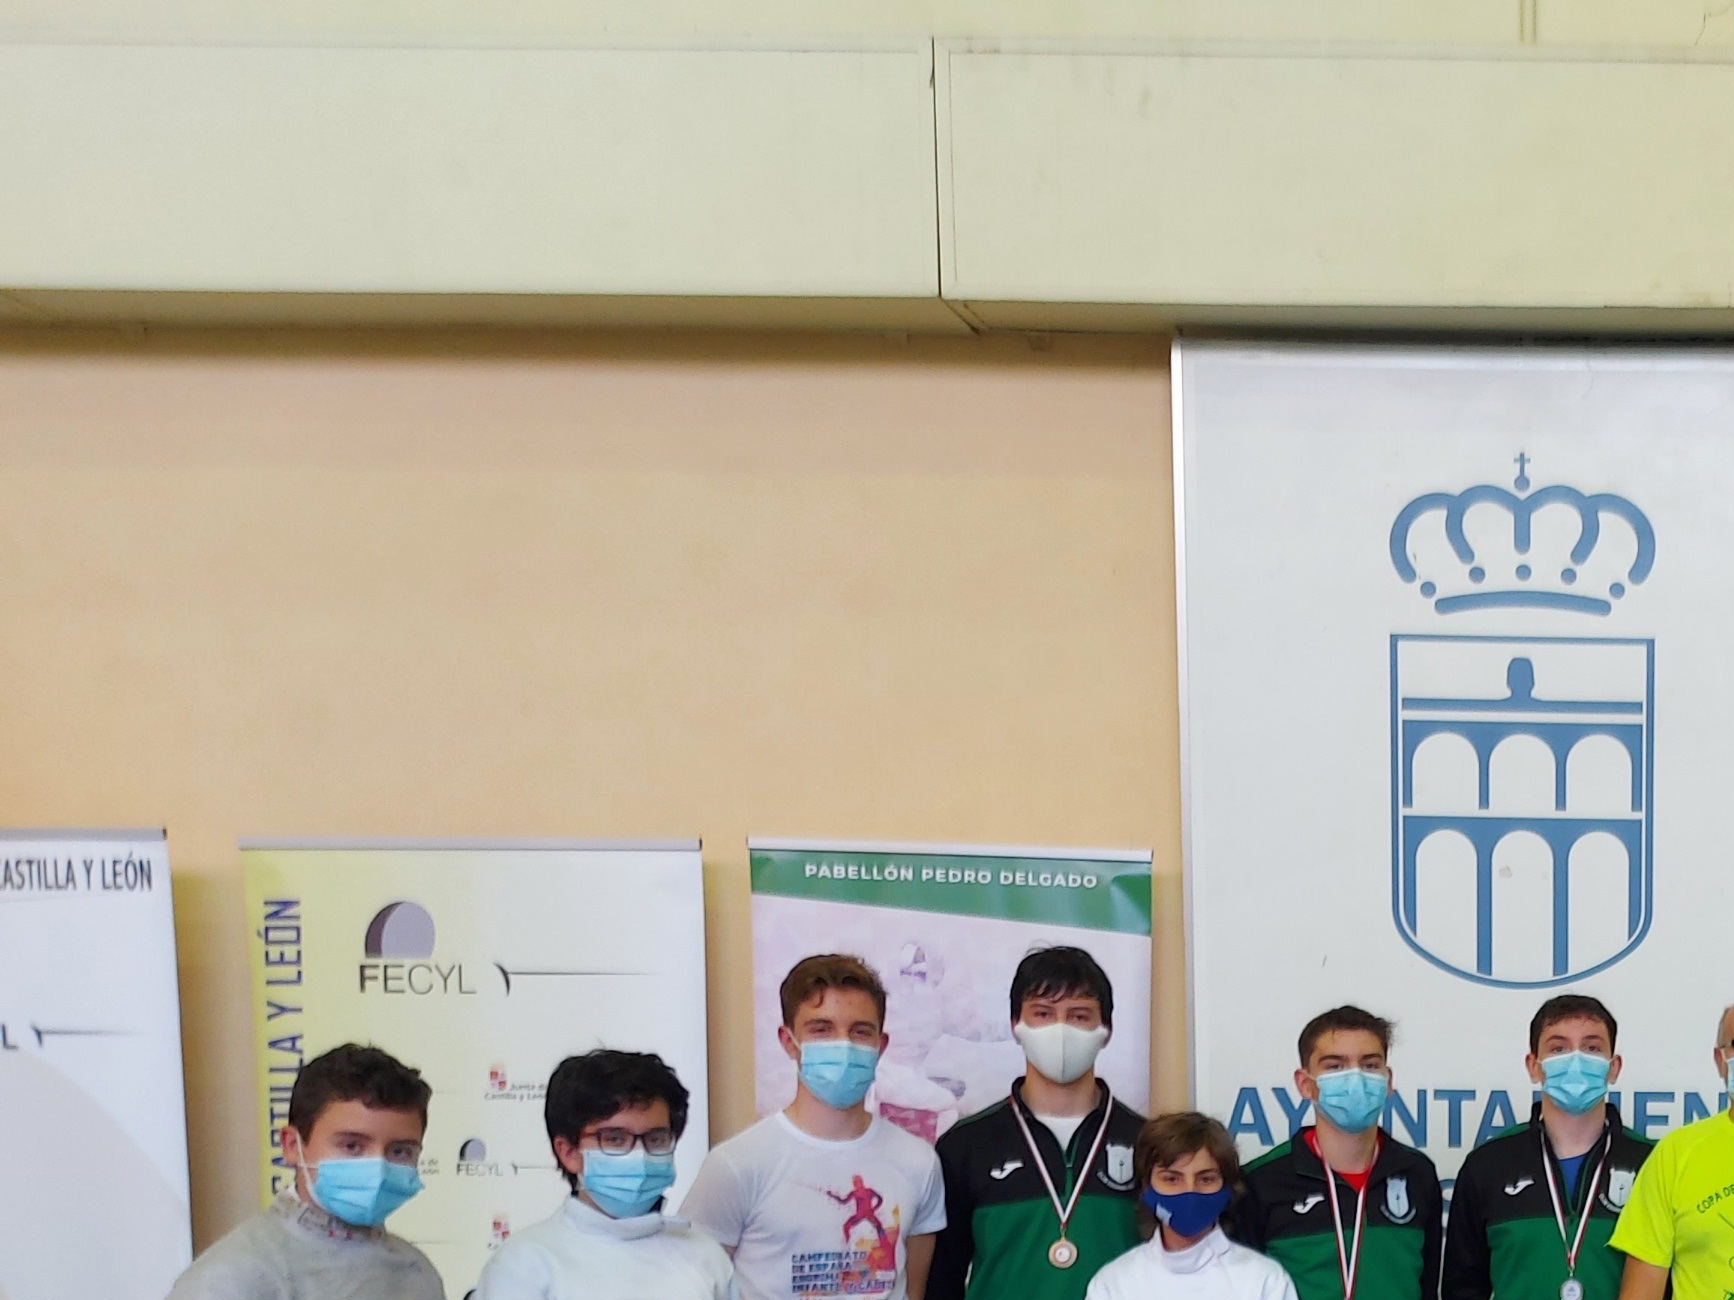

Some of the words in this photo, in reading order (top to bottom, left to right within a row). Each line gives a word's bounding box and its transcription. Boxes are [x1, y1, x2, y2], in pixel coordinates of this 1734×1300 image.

[0, 858, 77, 891] ASTILLA
[83, 859, 94, 891] Y
[101, 851, 153, 892] LEÓN
[804, 860, 913, 882] PABELLÓN
[920, 867, 993, 884] PEDRO
[999, 869, 1098, 889] DELGADO
[257, 899, 303, 987] LEÓN
[359, 963, 477, 995] FECYL
[266, 1000, 303, 1021] Y
[456, 1163, 504, 1176] FECYL
[1696, 1192, 1723, 1214] COPA
